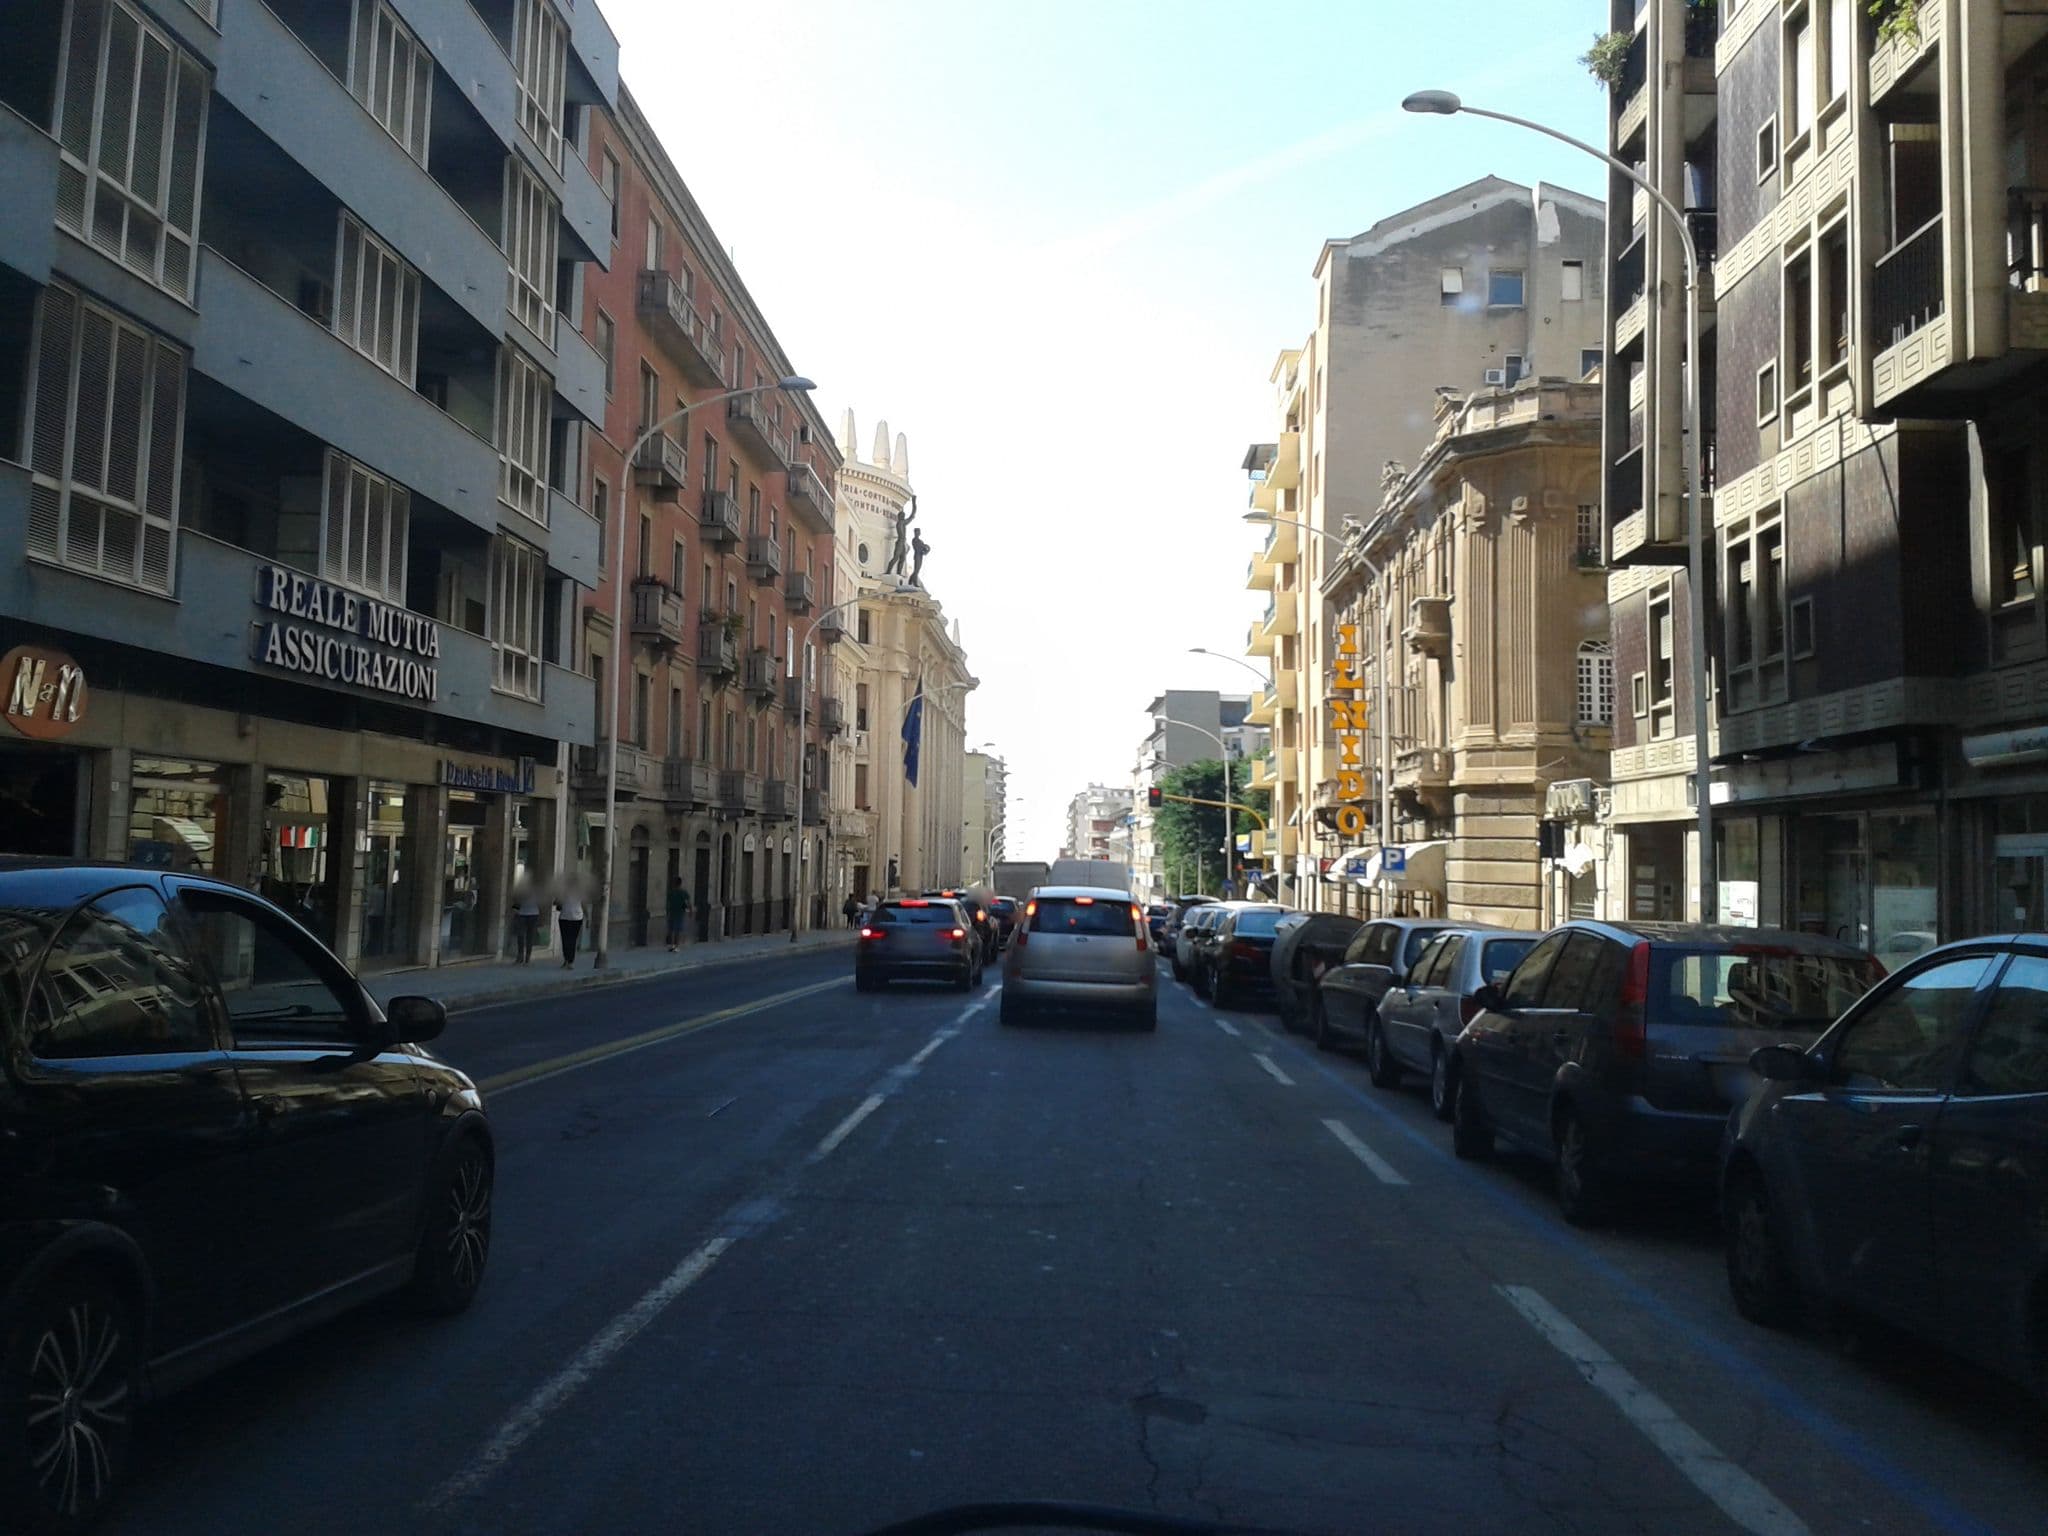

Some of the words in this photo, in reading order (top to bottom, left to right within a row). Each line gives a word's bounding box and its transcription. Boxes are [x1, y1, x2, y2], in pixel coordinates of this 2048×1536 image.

[269, 565, 359, 634] REALE
[367, 601, 441, 659] MUTUA
[265, 622, 438, 702] ASSICURAZIONI
[1334, 623, 1364, 689] IL
[1331, 701, 1369, 836] NIDO
[1385, 849, 1403, 869] P
